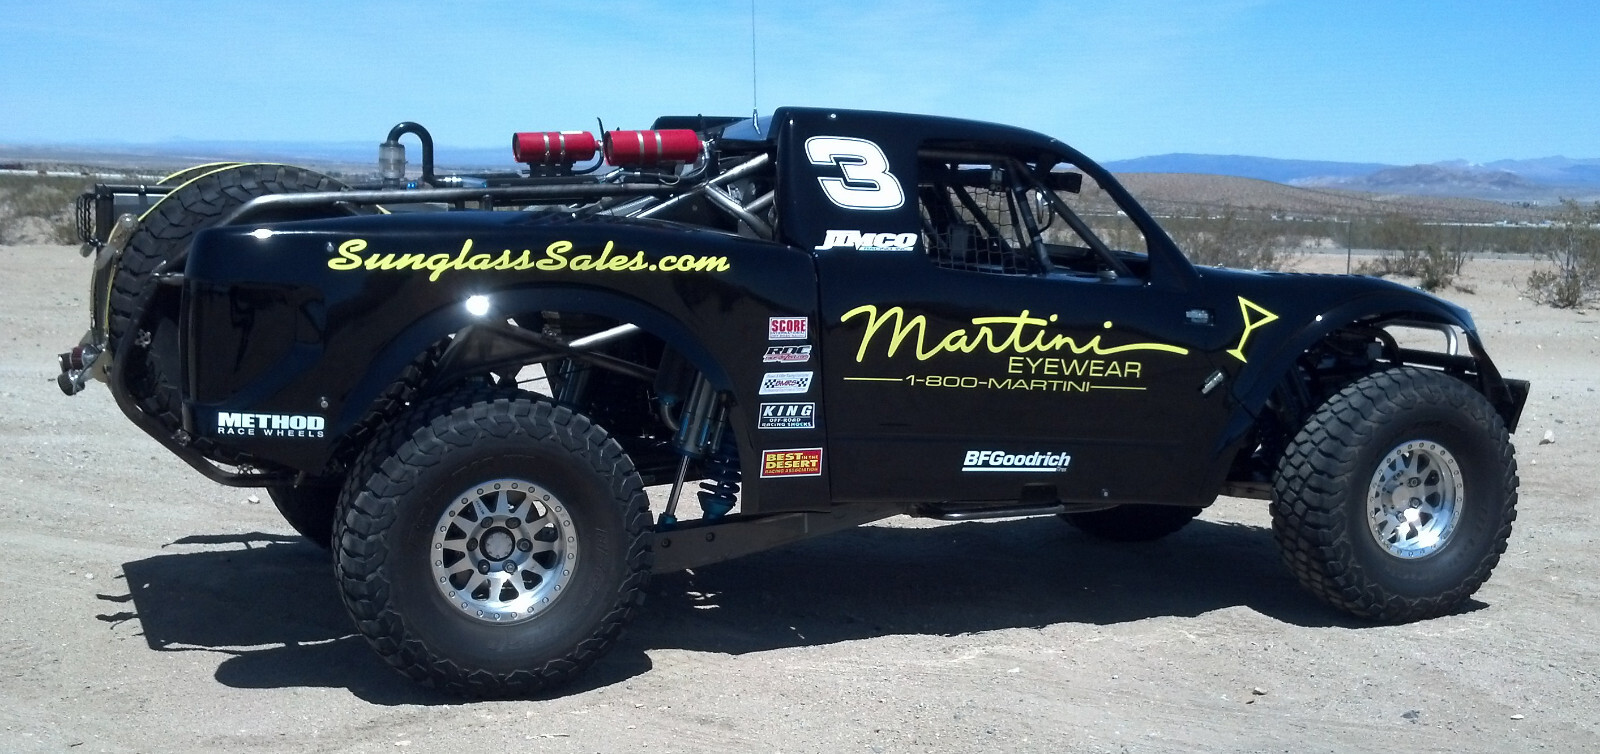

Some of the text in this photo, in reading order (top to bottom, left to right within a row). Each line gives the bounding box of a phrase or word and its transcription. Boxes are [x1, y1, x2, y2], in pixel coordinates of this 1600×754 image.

[804, 136, 905, 210] 3
[815, 230, 918, 250] JIMCO
[327, 238, 730, 282] SunglassSales.com
[772, 320, 806, 332] SCORE
[841, 304, 1188, 362] Martini
[1007, 356, 1142, 378] EYEWEAR
[905, 374, 1091, 393] 1-800-MARTINI
[763, 405, 813, 416] KING
[218, 412, 325, 430] METHOD
[217, 427, 324, 438] RACE WHEELS
[766, 453, 803, 461] BEST
[766, 460, 818, 469] DESERT
[963, 451, 1071, 467] BFGoodrich
